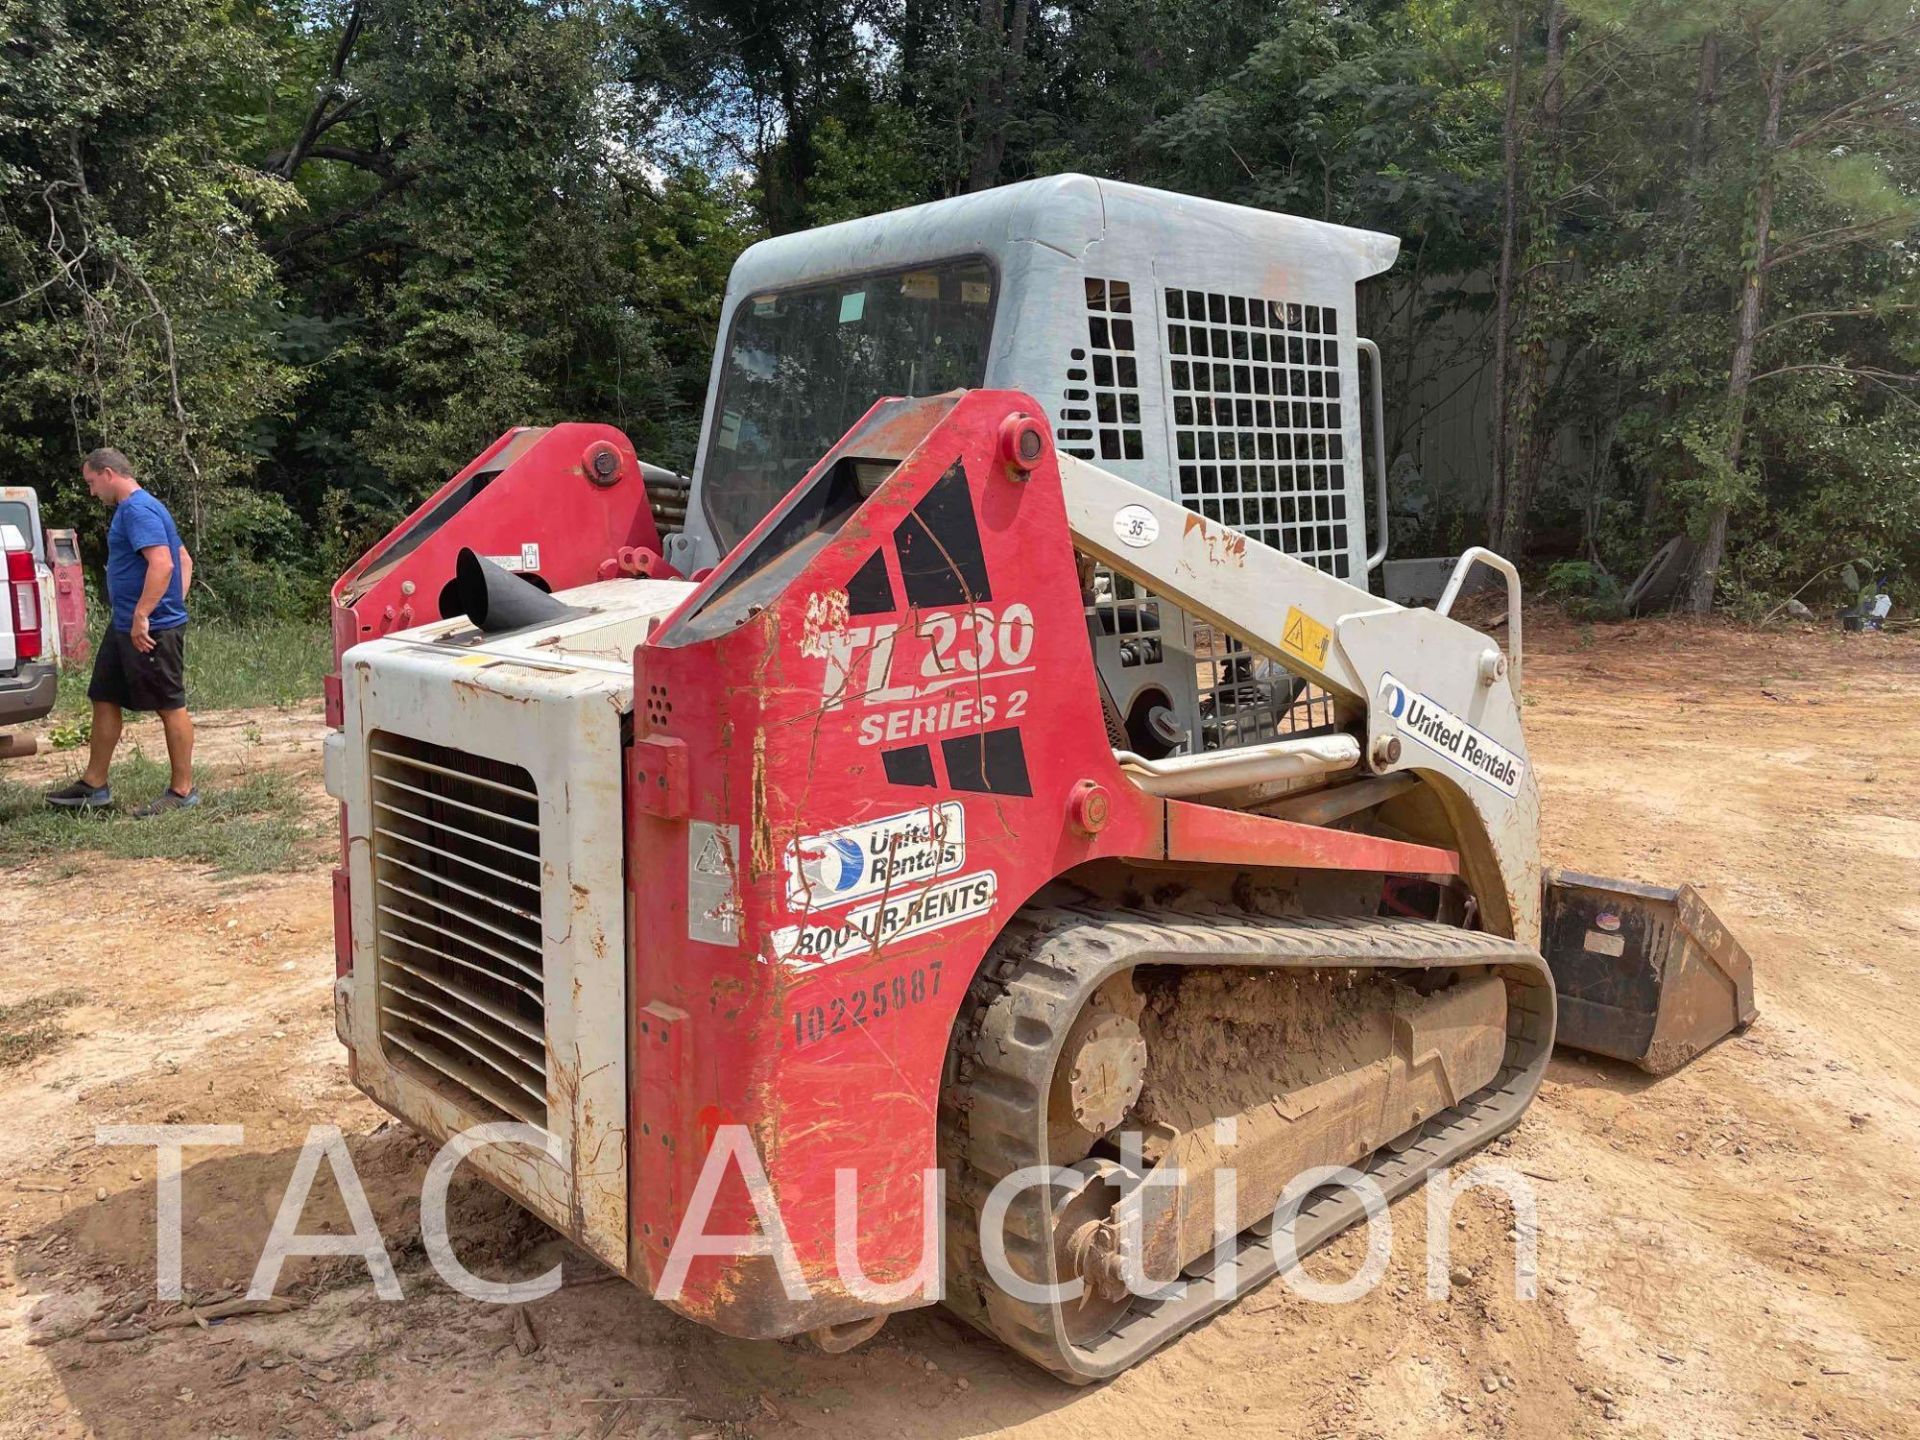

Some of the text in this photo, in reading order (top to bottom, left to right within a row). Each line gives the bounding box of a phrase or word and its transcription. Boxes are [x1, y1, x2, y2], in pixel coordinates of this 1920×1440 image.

[1129, 520, 1144, 536] 35
[820, 603, 1034, 711] TL 230
[858, 690, 1029, 746] SERIES 2
[1406, 700, 1517, 786] United Rentals
[870, 845, 957, 884] Rentals
[795, 960, 943, 1045] 10225887
